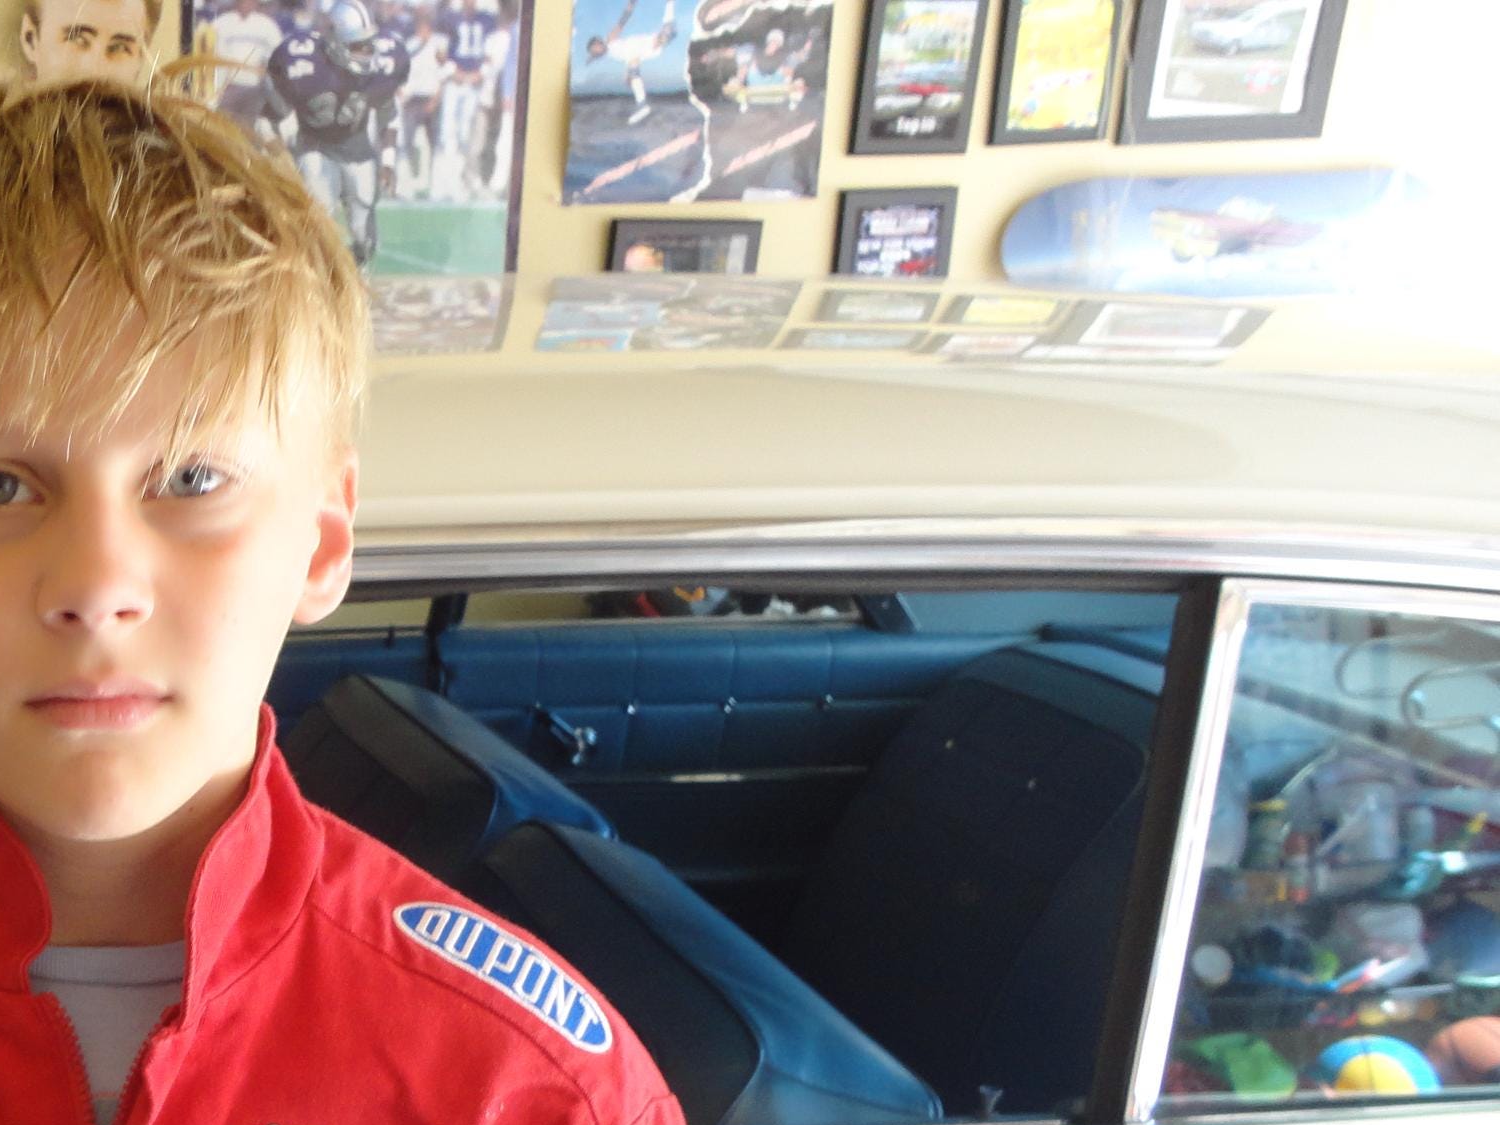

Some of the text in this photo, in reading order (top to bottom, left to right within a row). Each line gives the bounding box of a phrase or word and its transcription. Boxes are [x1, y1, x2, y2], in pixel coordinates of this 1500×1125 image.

[456, 22, 484, 58] 11
[415, 907, 600, 1041] DU PONT
